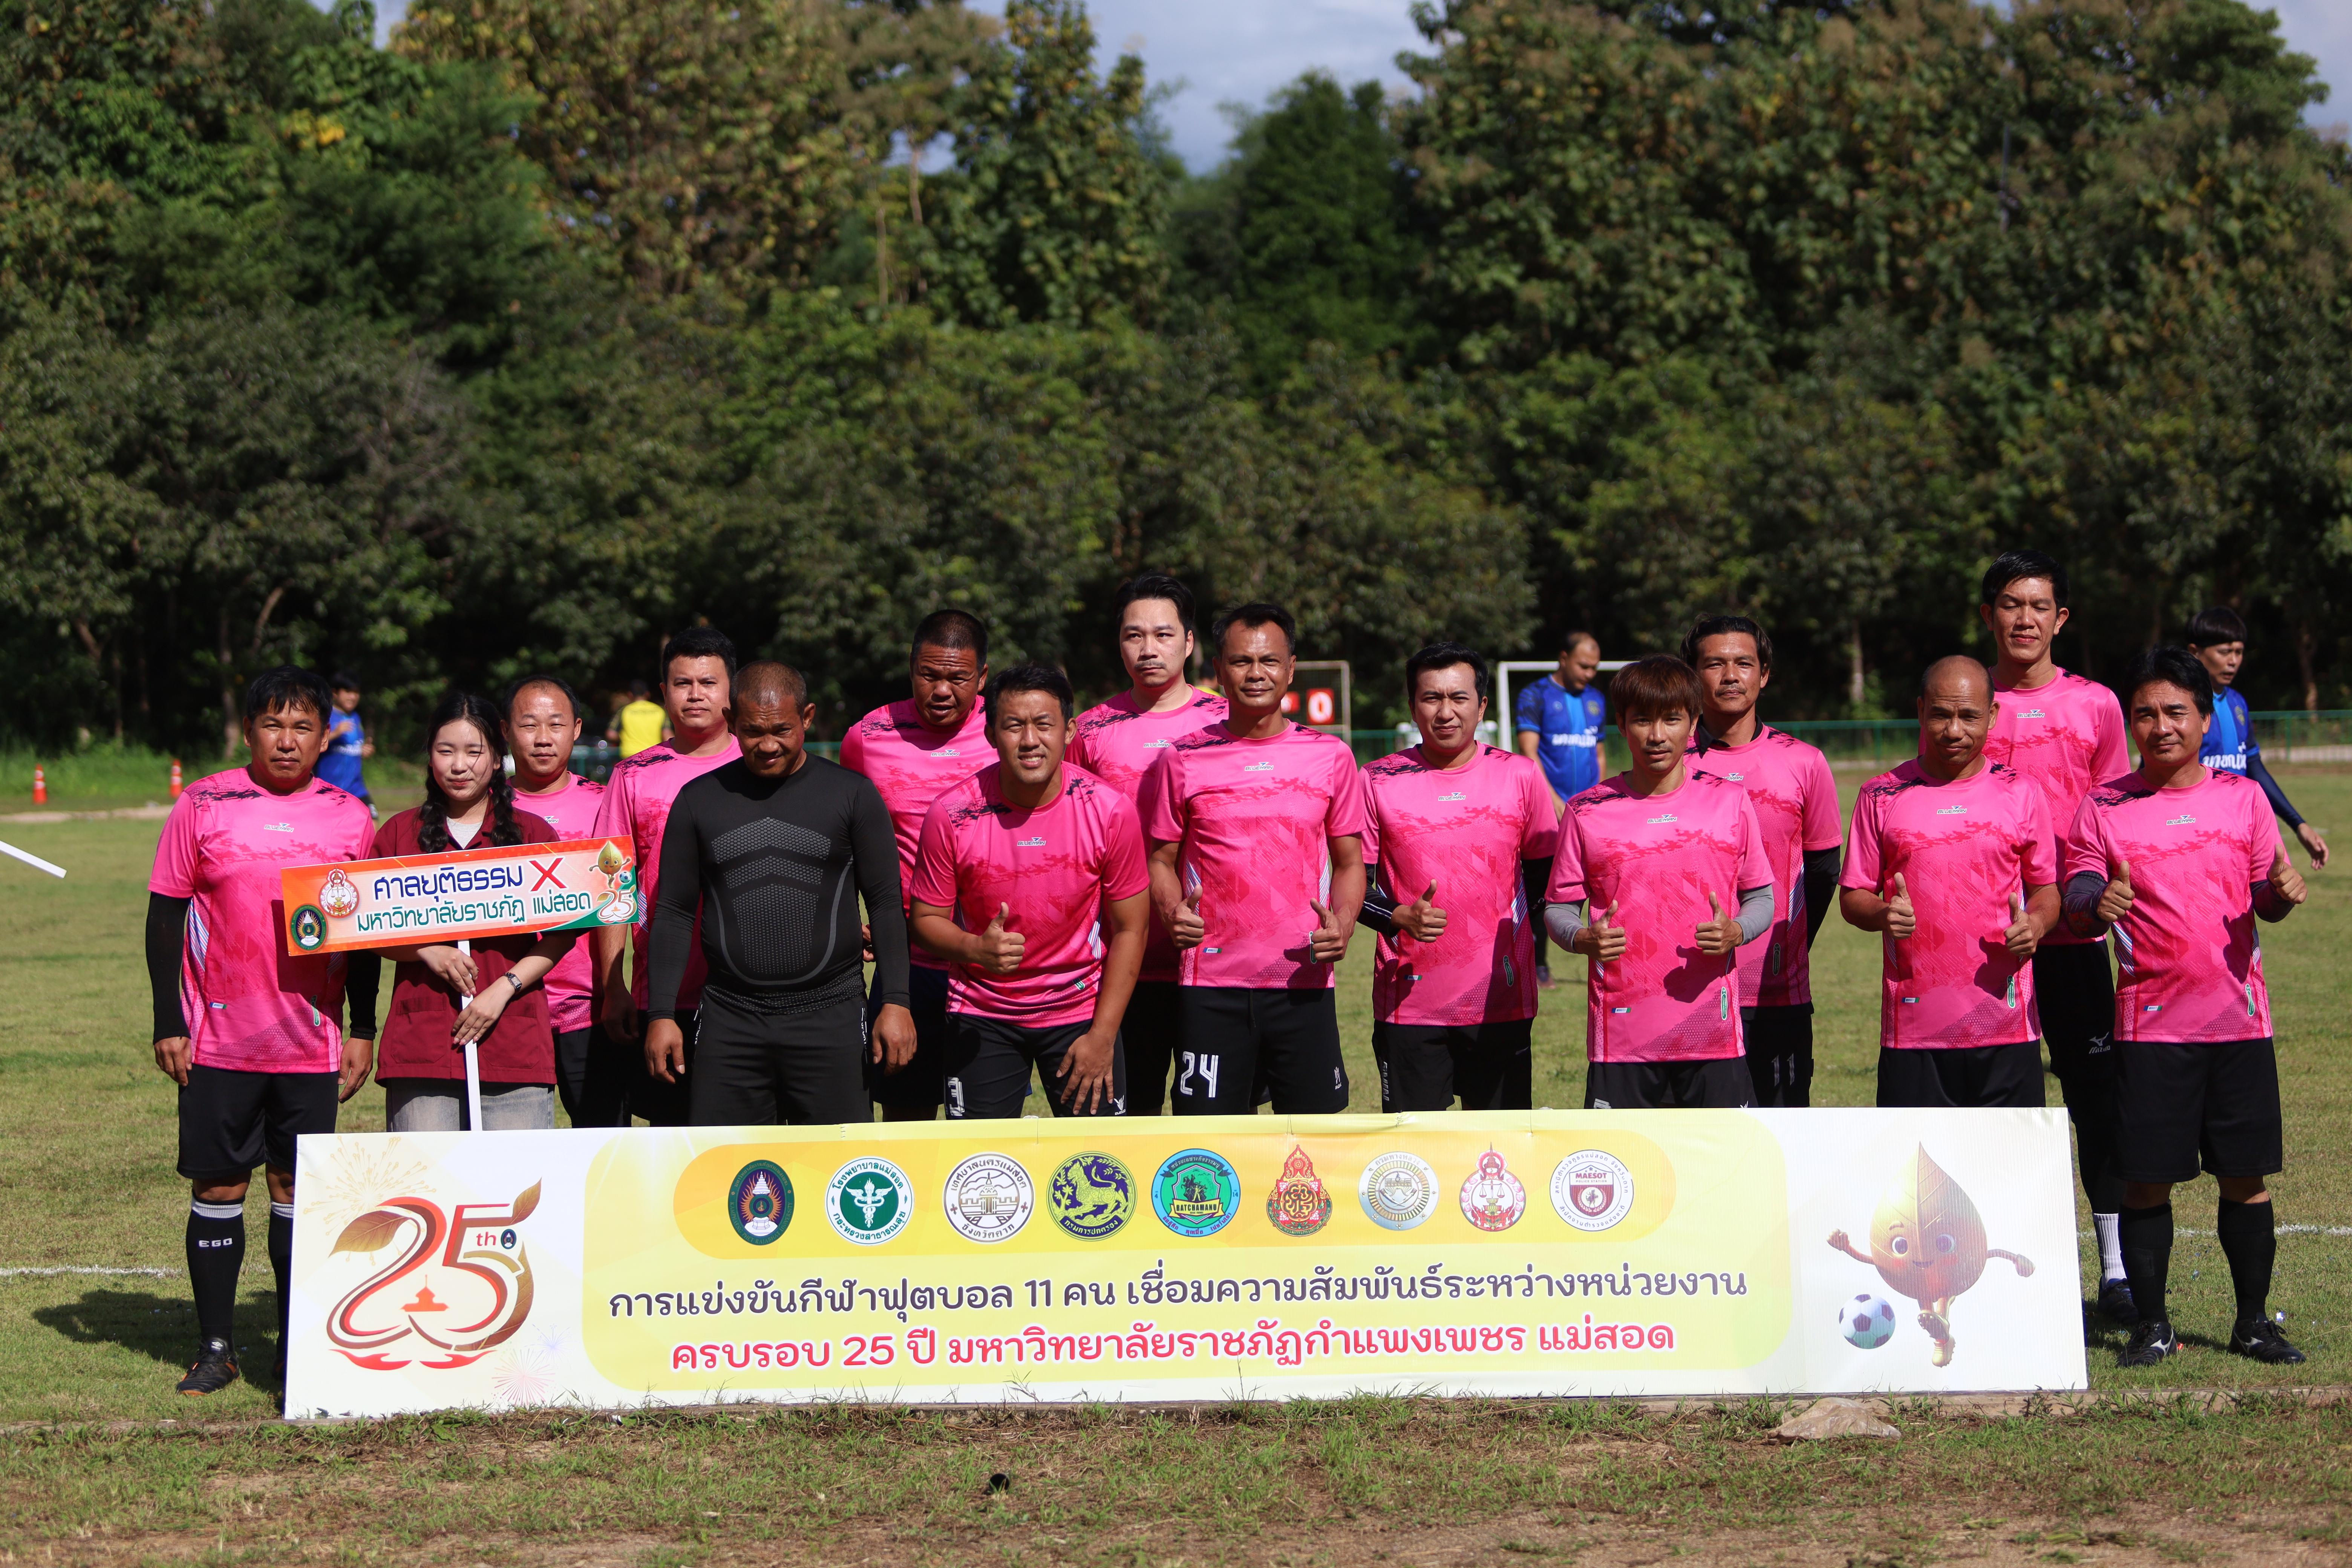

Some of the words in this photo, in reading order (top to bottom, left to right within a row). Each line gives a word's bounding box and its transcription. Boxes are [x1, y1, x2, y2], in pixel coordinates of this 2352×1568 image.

[1308, 691, 1333, 723] 0
[374, 866, 522, 901] ศาลยุติธรรม
[530, 857, 567, 892] X
[358, 894, 525, 931] มหาวิทยาลัยราชภัฏ
[533, 892, 592, 915] แม่สอด
[1180, 1051, 1219, 1098] 24
[951, 1159, 1027, 1191] เทศบาลนครแม่สอด
[1375, 1154, 1421, 1166] กรมทางหลวง
[832, 1162, 904, 1189] โรงพยาบาลแม่สอด
[742, 1232, 753, 1242] PHET
[833, 1211, 906, 1240] กระทรวงสาธารณสุข
[962, 1223, 1015, 1239] จังหวัดตาก
[1064, 1220, 1119, 1235] กรมการปกครอง
[198, 1238, 233, 1248] EGO
[609, 1277, 1012, 1323] การแข่งขันกีฬาฟุตบอล
[1024, 1280, 1051, 1307] 11
[1064, 1282, 1115, 1306] คน
[1128, 1259, 1747, 1305] เชื่อมความสัมพันธ์ระหว่างหน่วยงาน
[674, 1342, 830, 1369] ครบรอบ
[844, 1336, 894, 1366] 25
[907, 1327, 936, 1364] ปี
[949, 1320, 1527, 1366] มหาวิทยาลัยราชภัฏกำแพงเพชร
[1539, 1315, 1674, 1351] แม่สอด
